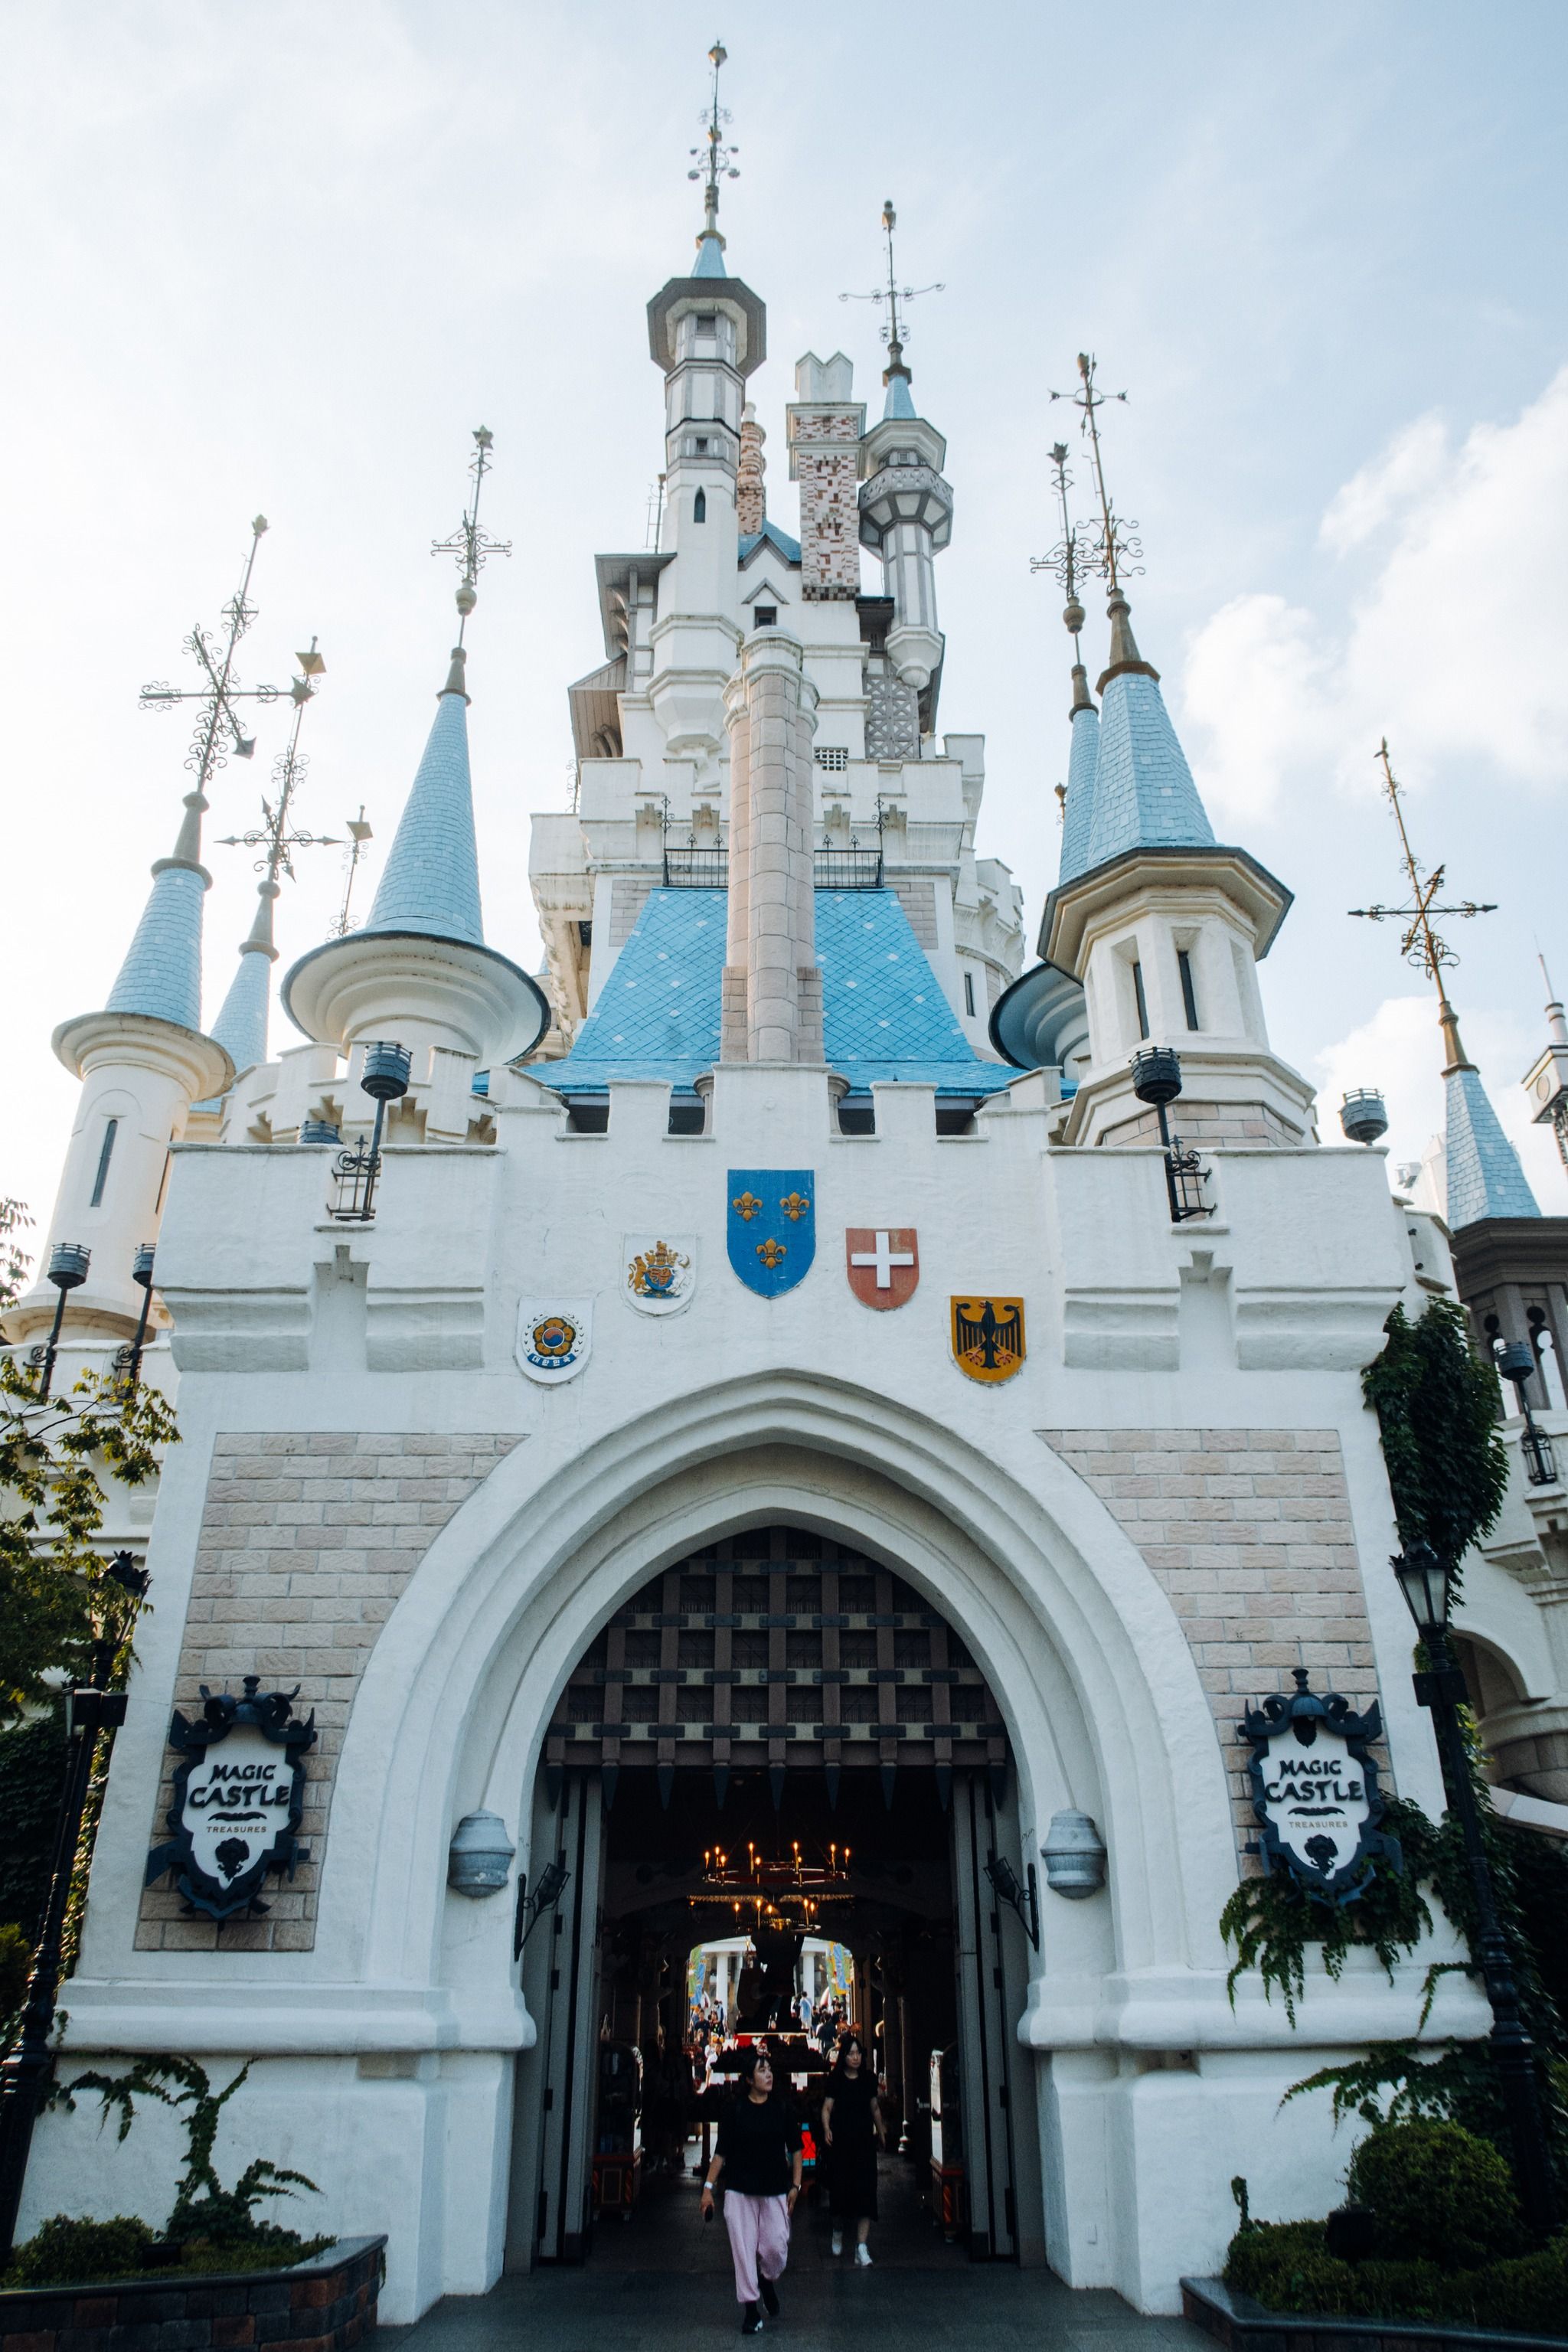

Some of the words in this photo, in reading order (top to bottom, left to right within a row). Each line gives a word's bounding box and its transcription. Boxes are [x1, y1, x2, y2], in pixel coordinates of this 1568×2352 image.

[531, 1355, 570, 1367] 대한민국
[208, 1763, 277, 1785] MAGIC
[1279, 1759, 1342, 1780] MAGIC
[188, 1784, 290, 1808] CASTLE
[1264, 1779, 1364, 1803] CASTLE
[1289, 1821, 1348, 1829] TREASURES
